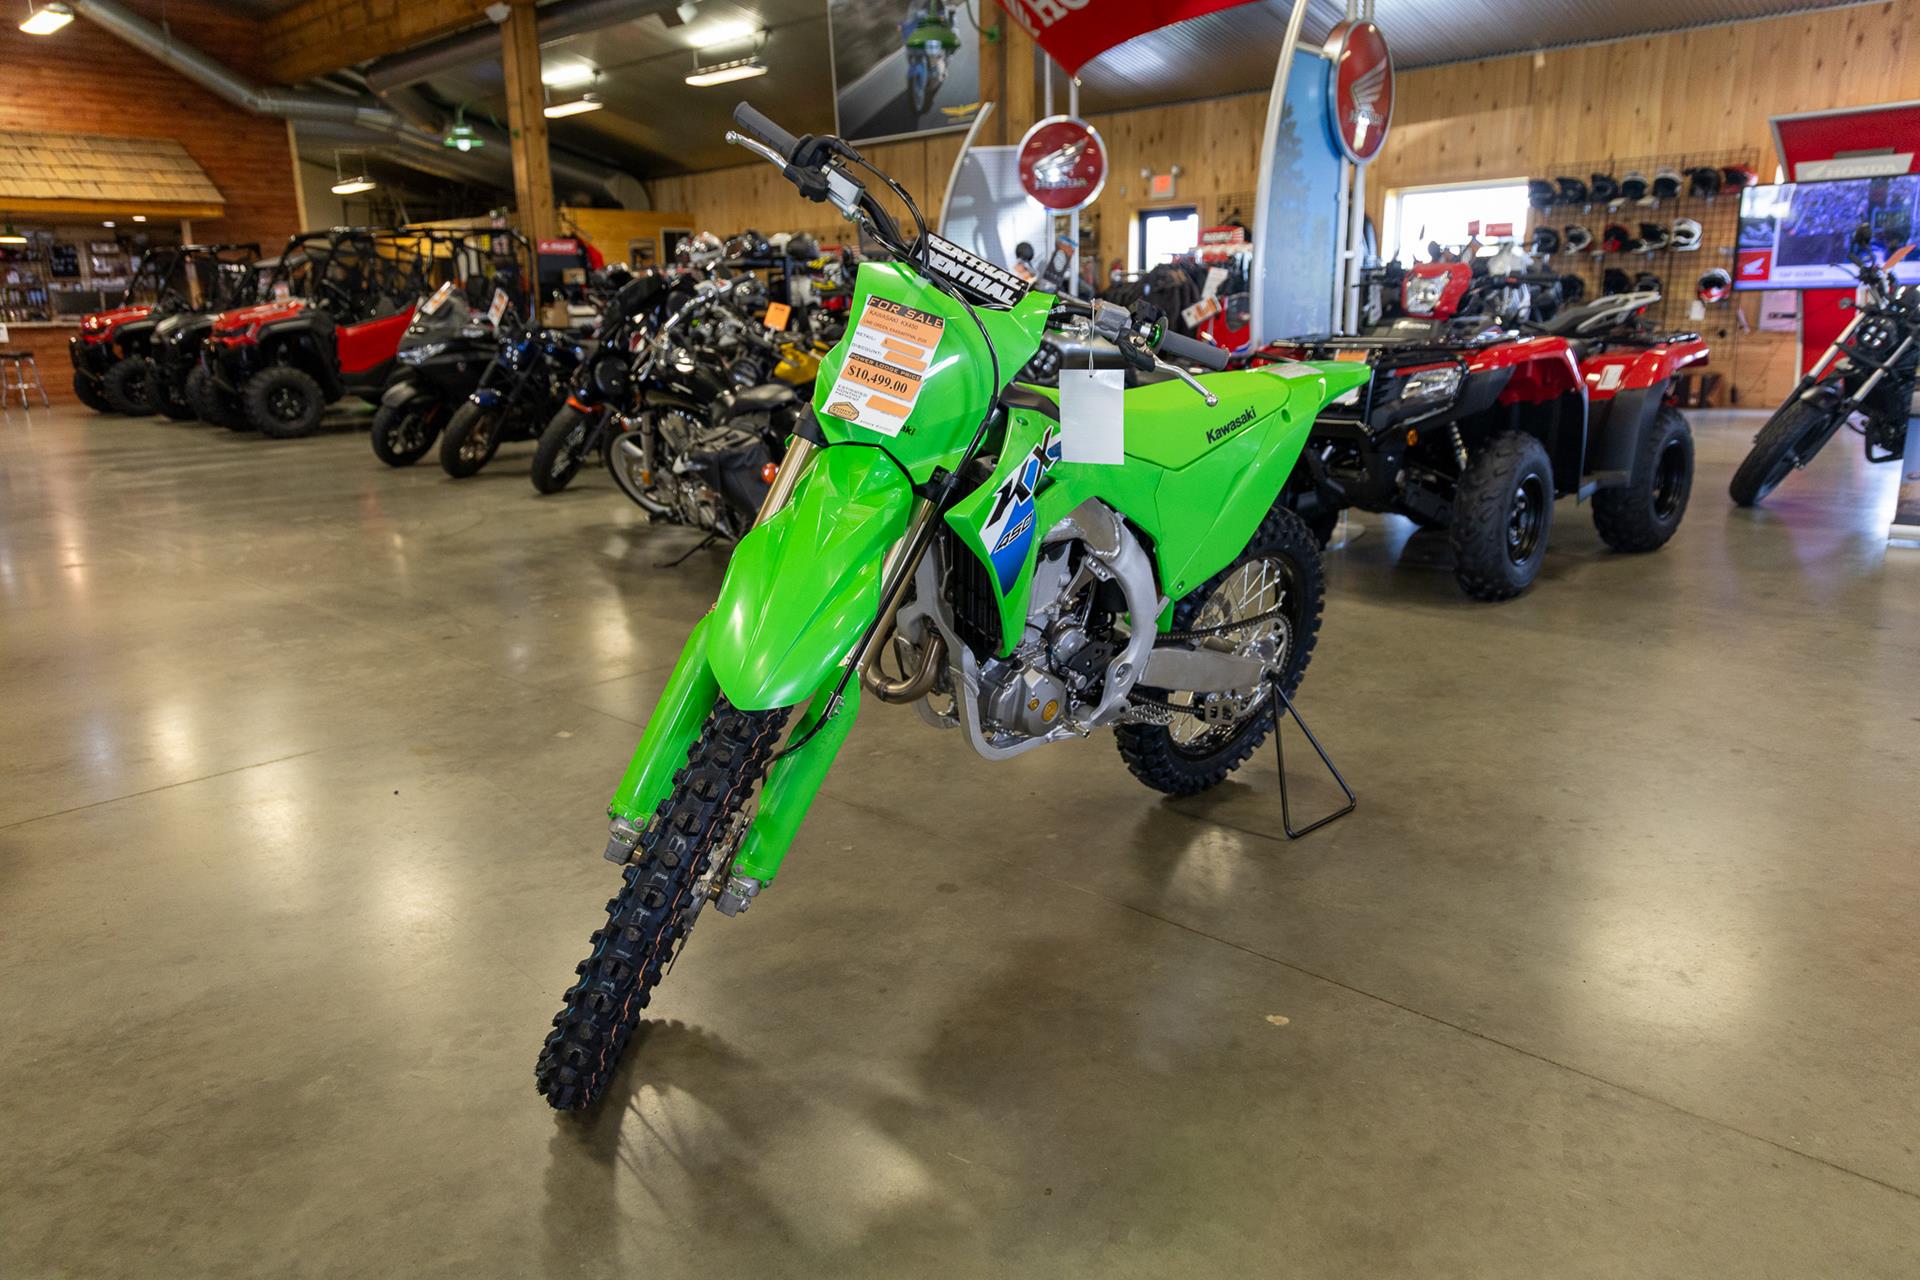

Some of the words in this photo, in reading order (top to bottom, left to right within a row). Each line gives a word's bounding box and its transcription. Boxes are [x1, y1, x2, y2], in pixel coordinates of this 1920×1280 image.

[868, 297, 901, 314] FOR
[904, 308, 943, 328] SALE
[848, 364, 908, 394] $10,499.00
[850, 353, 876, 365] POWER
[899, 370, 921, 381] PRICE
[1206, 405, 1257, 444] Kawasaki
[985, 426, 1054, 530] KX
[995, 511, 1033, 552] 450
